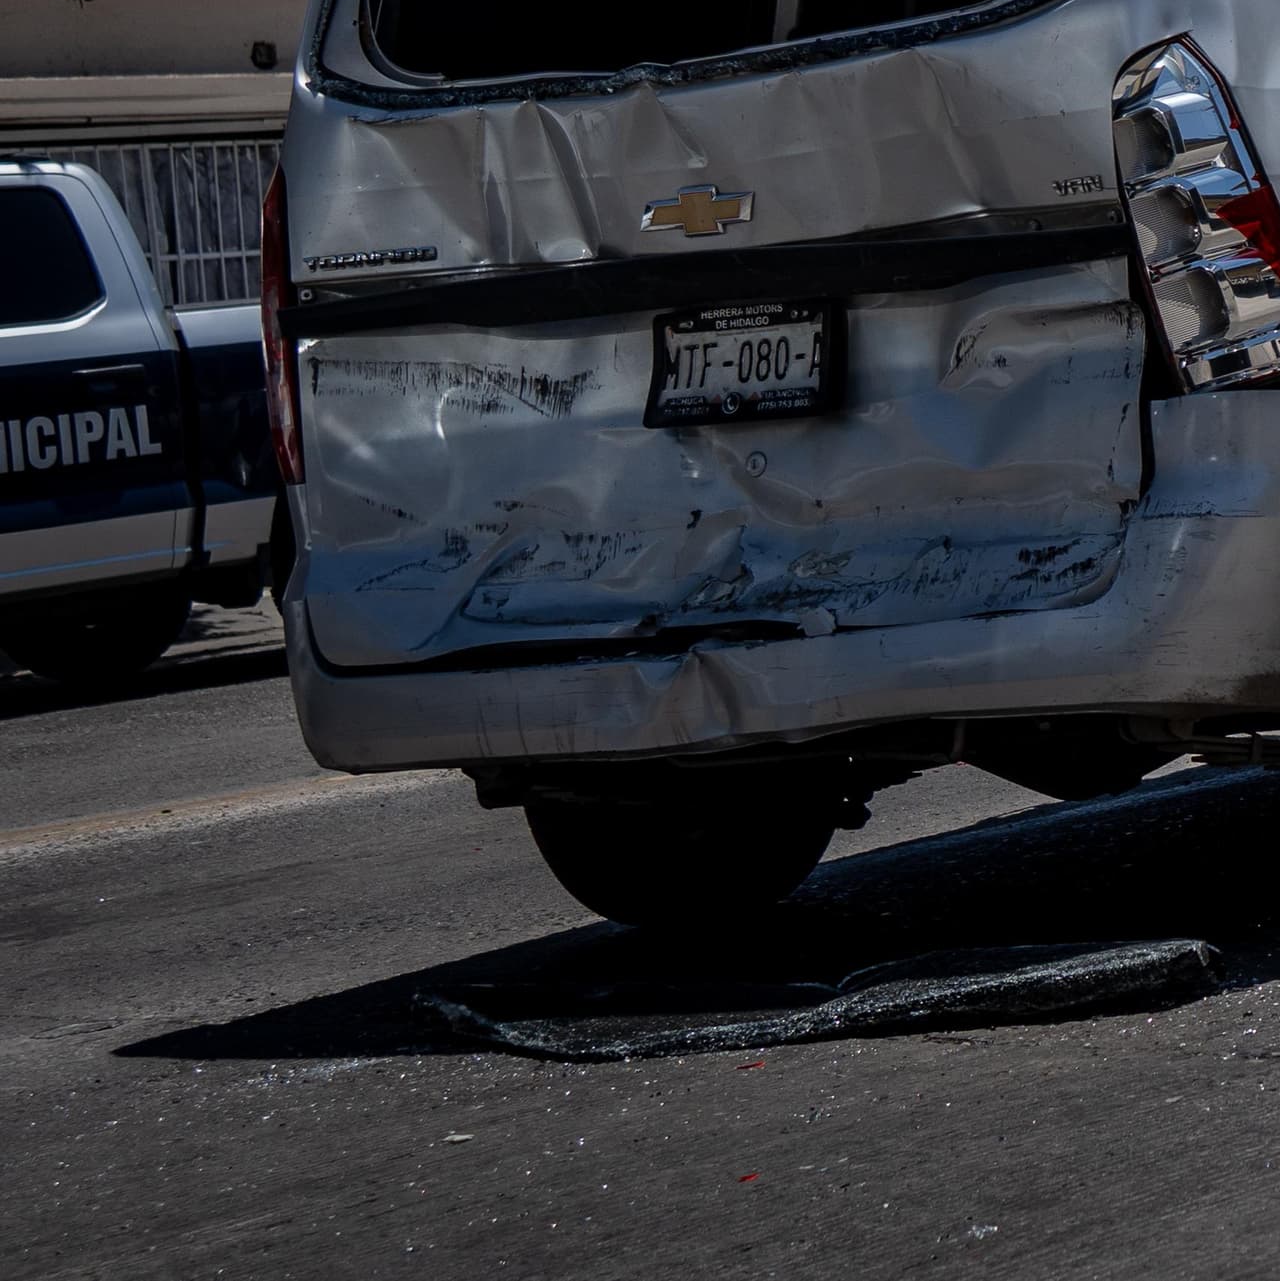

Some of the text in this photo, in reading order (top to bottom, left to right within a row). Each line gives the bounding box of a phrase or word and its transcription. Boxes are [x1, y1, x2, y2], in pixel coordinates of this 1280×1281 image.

[1052, 175, 1103, 196] VAN
[303, 246, 438, 272] TORNADO
[701, 304, 783, 320] HERRERA MOTORS
[716, 316, 770, 330] DE HIDALGO
